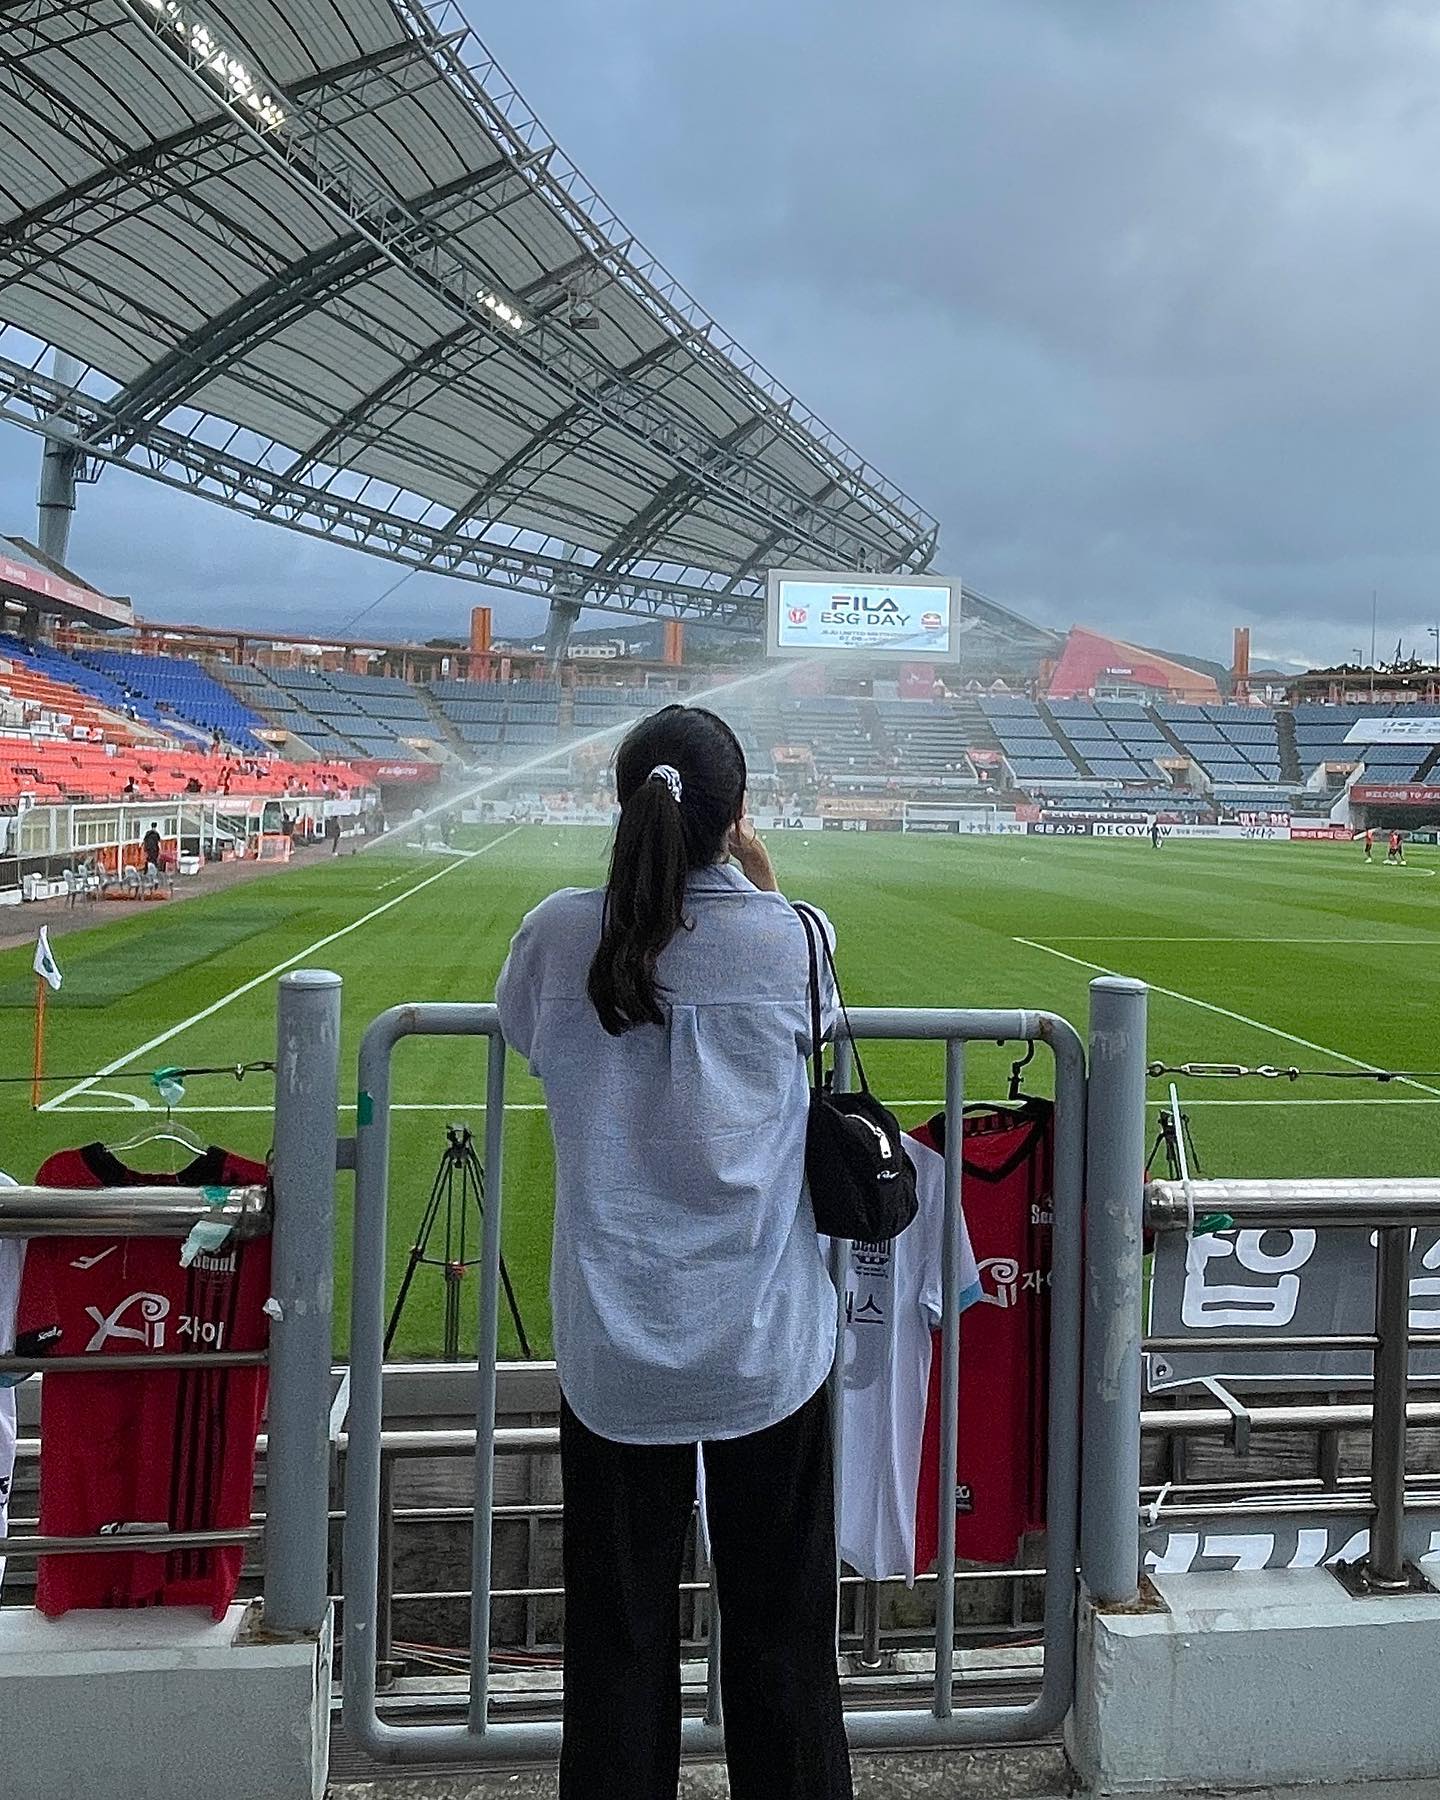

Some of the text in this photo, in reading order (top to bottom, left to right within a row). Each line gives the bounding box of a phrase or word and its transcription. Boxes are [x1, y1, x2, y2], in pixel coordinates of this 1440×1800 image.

[831, 595, 899, 612] FILA
[820, 612, 859, 625] ESG
[867, 614, 911, 626] DAY
[773, 818, 804, 829] FILA
[176, 1314, 225, 1350] 자이
